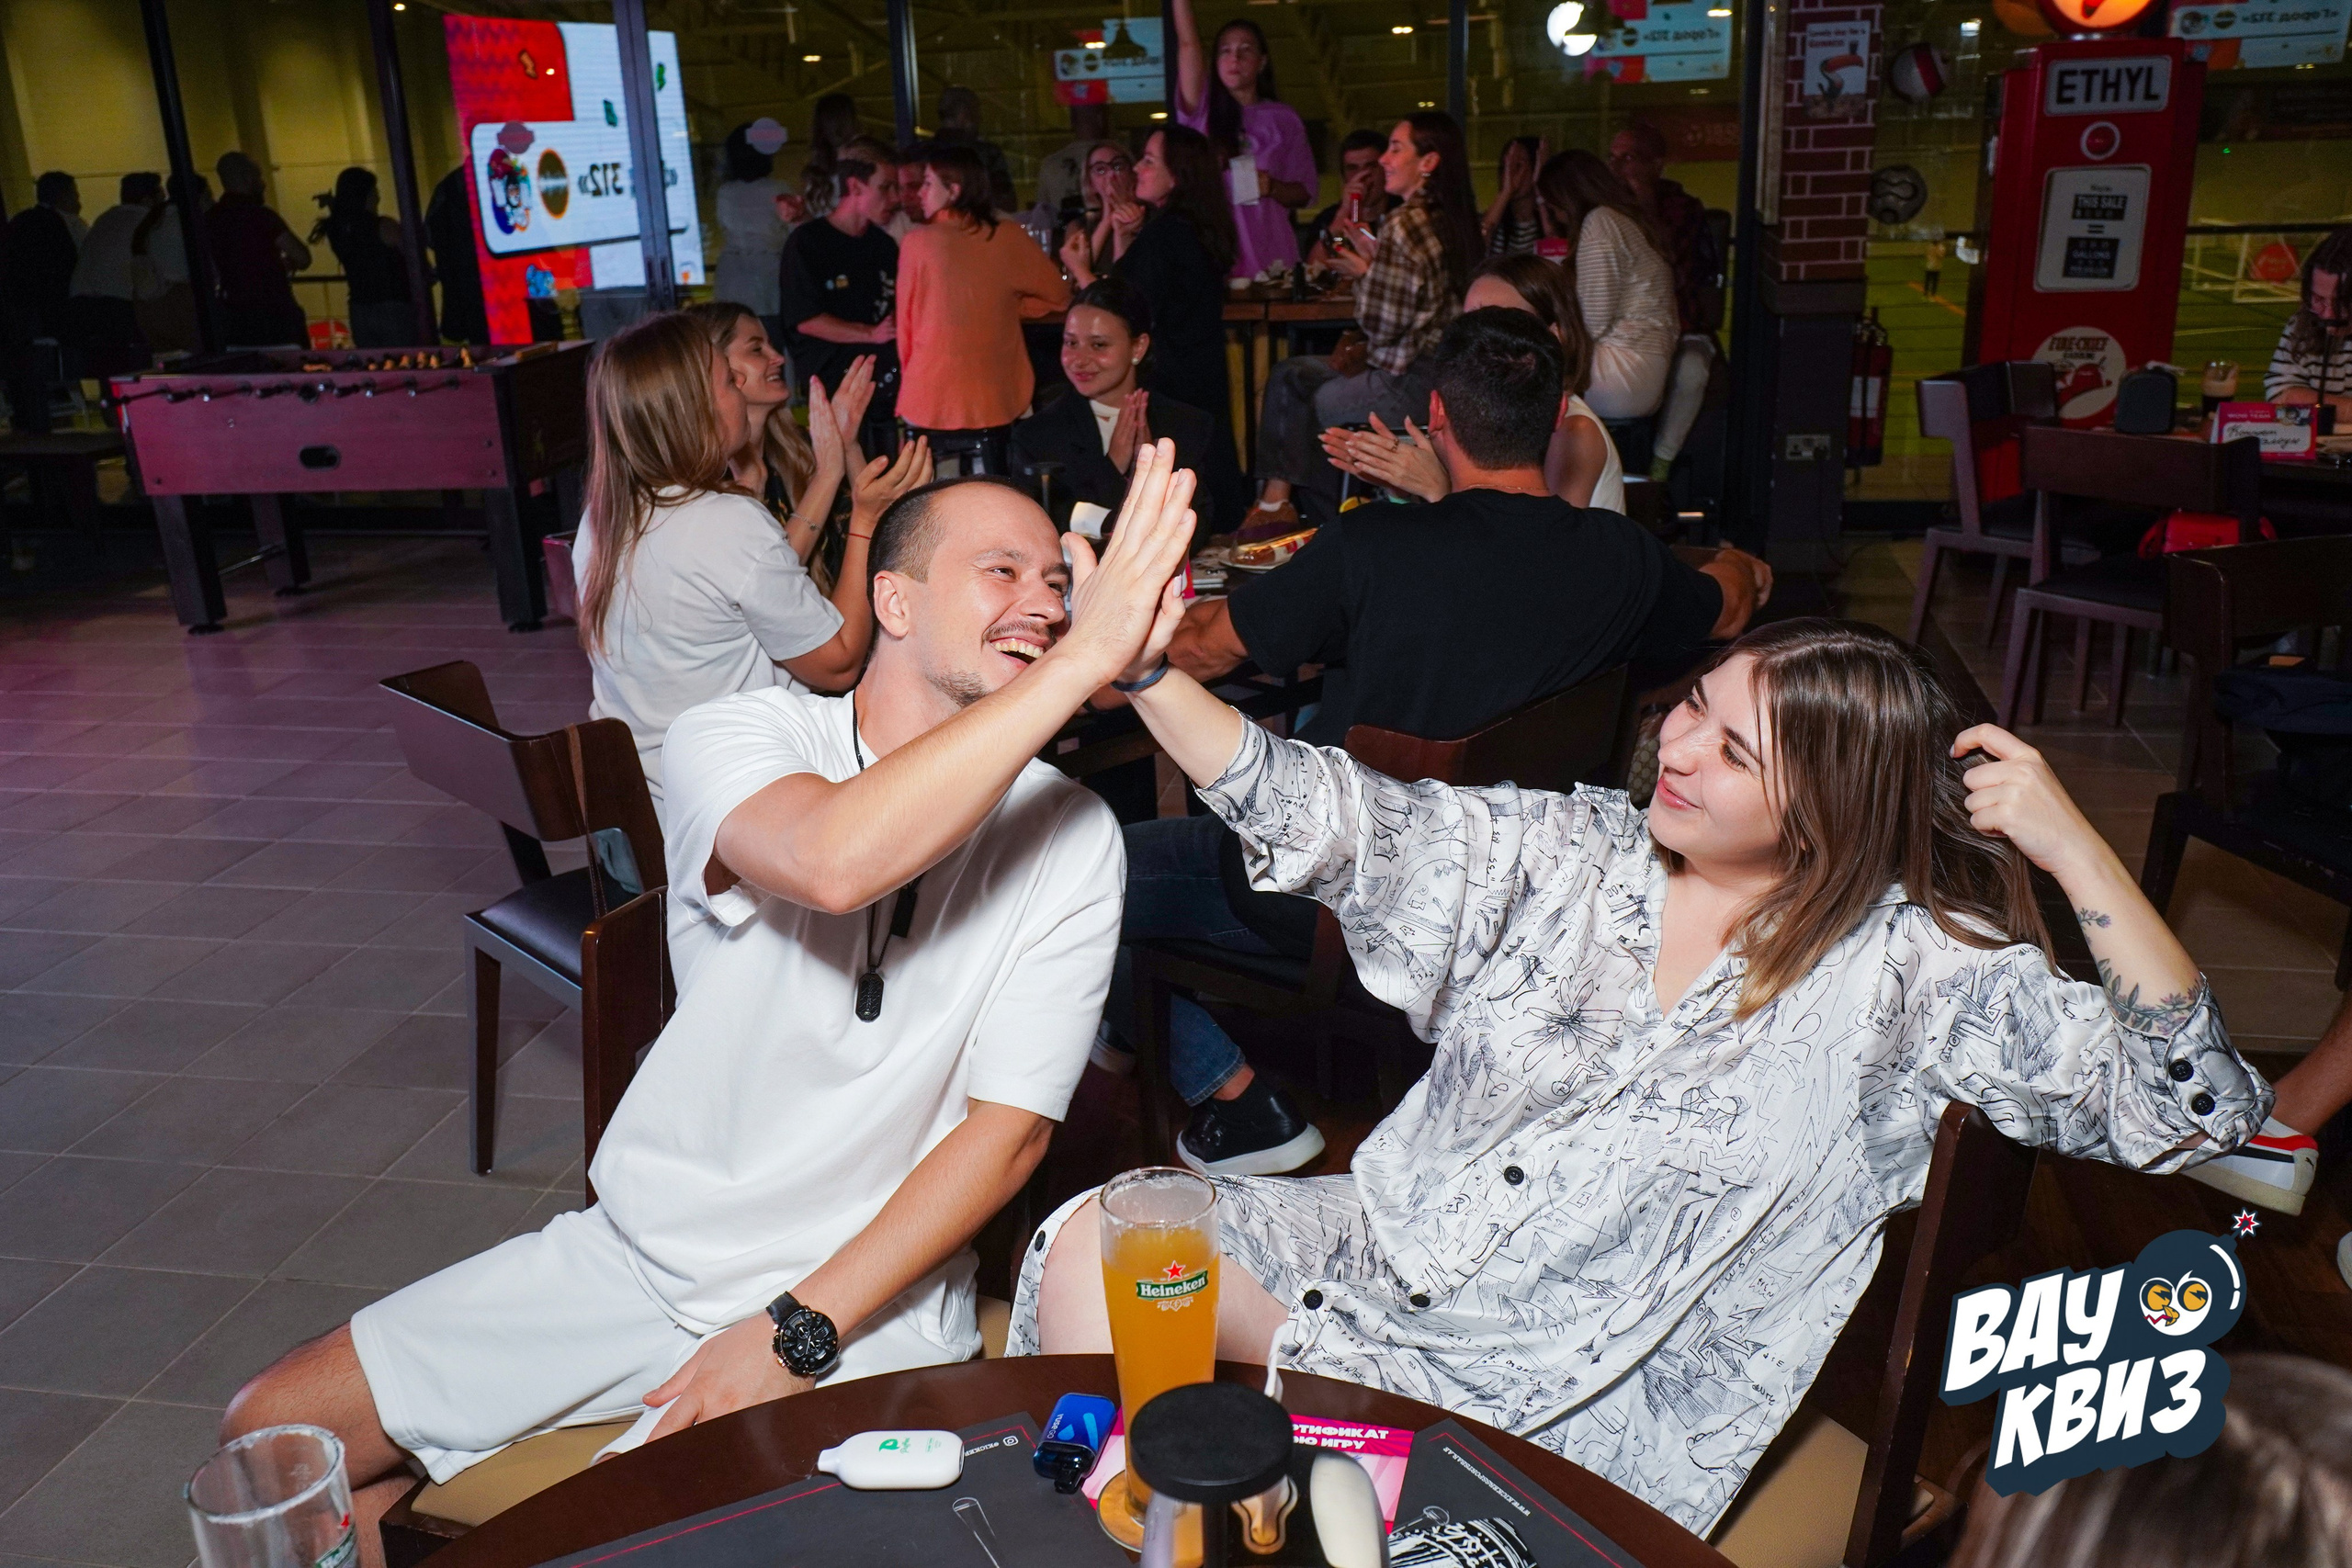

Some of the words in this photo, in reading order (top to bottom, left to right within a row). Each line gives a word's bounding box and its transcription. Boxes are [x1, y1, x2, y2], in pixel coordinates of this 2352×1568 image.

[2056, 66, 2159, 105] ETHYL
[2077, 196, 2098, 209] THIS
[2100, 197, 2123, 209] SALE
[1140, 1275, 1205, 1297] Heineken
[1320, 1438, 1365, 1450] ИГРУ
